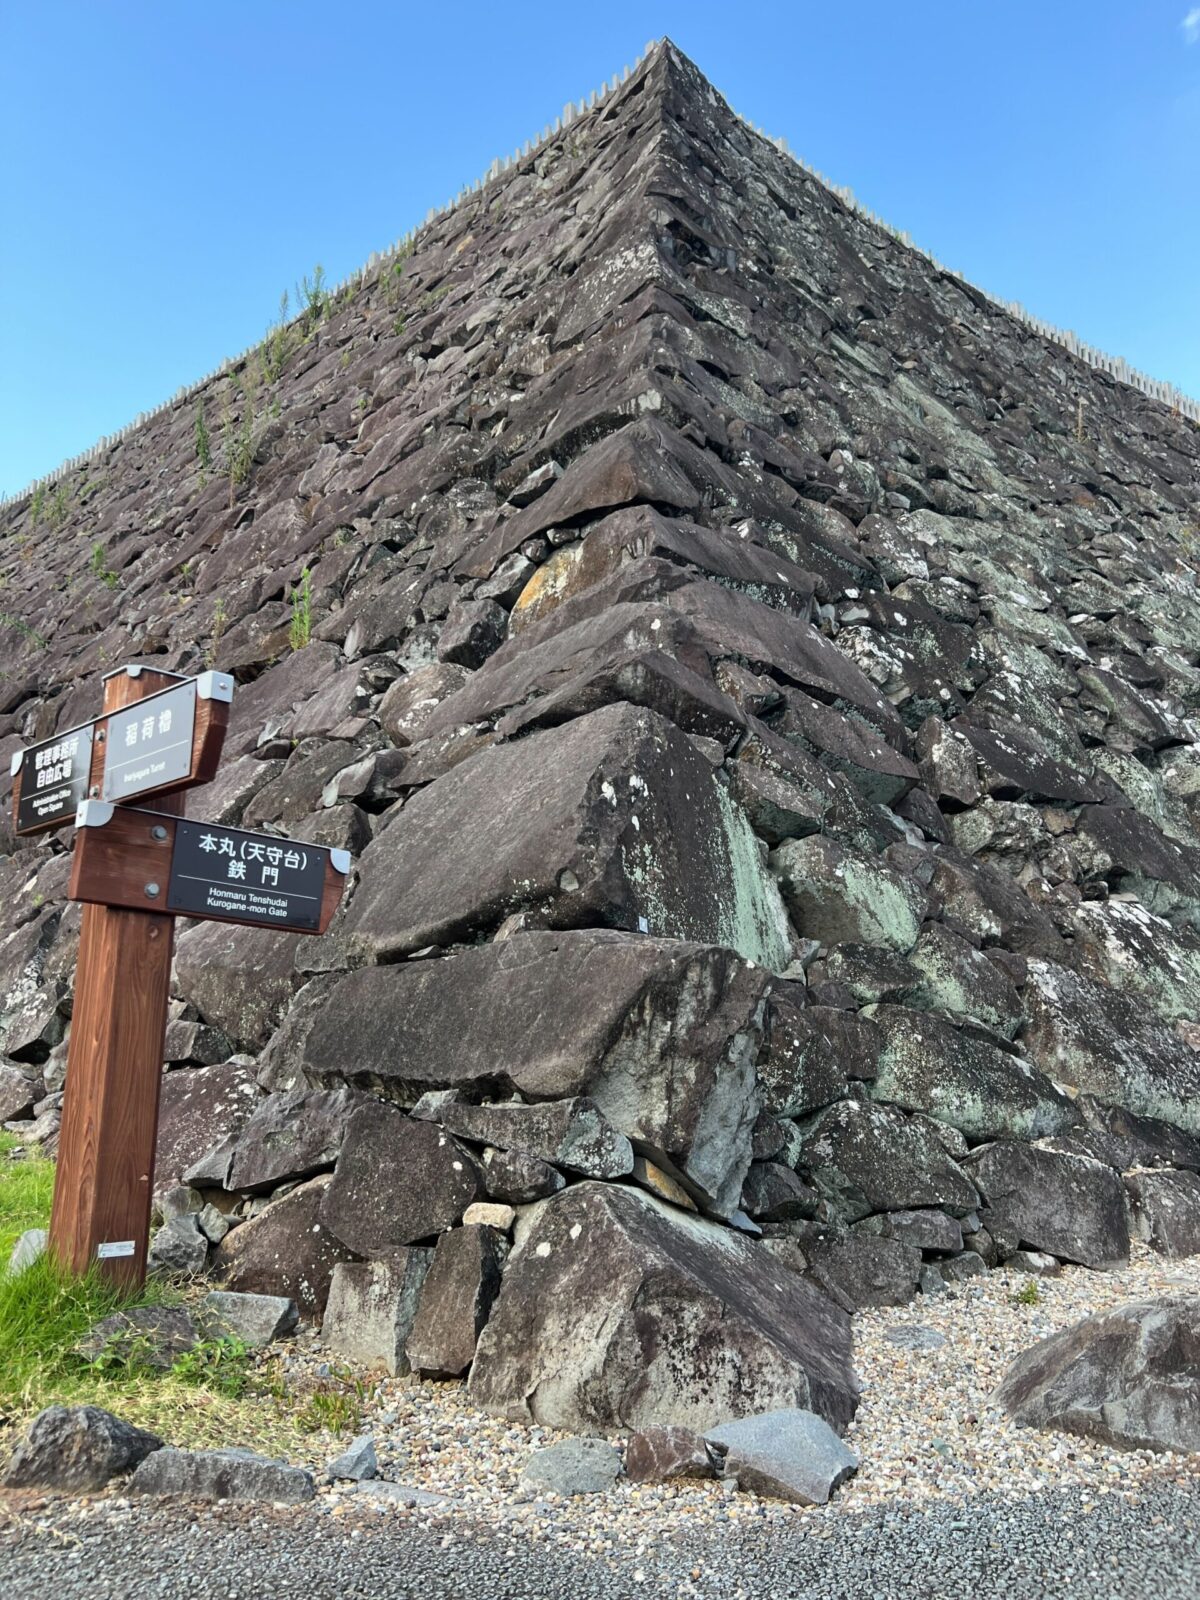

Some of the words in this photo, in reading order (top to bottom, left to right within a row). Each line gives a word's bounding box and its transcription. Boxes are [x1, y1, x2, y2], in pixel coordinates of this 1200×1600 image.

[36, 759, 72, 788] 自由広場
[198, 834, 307, 870] 本丸(天守台)
[207, 897, 267, 914] Kurogane-mon
[268, 907, 288, 917] Gate
[209, 887, 247, 901] Honmaru
[248, 893, 288, 907] Tenshudai
